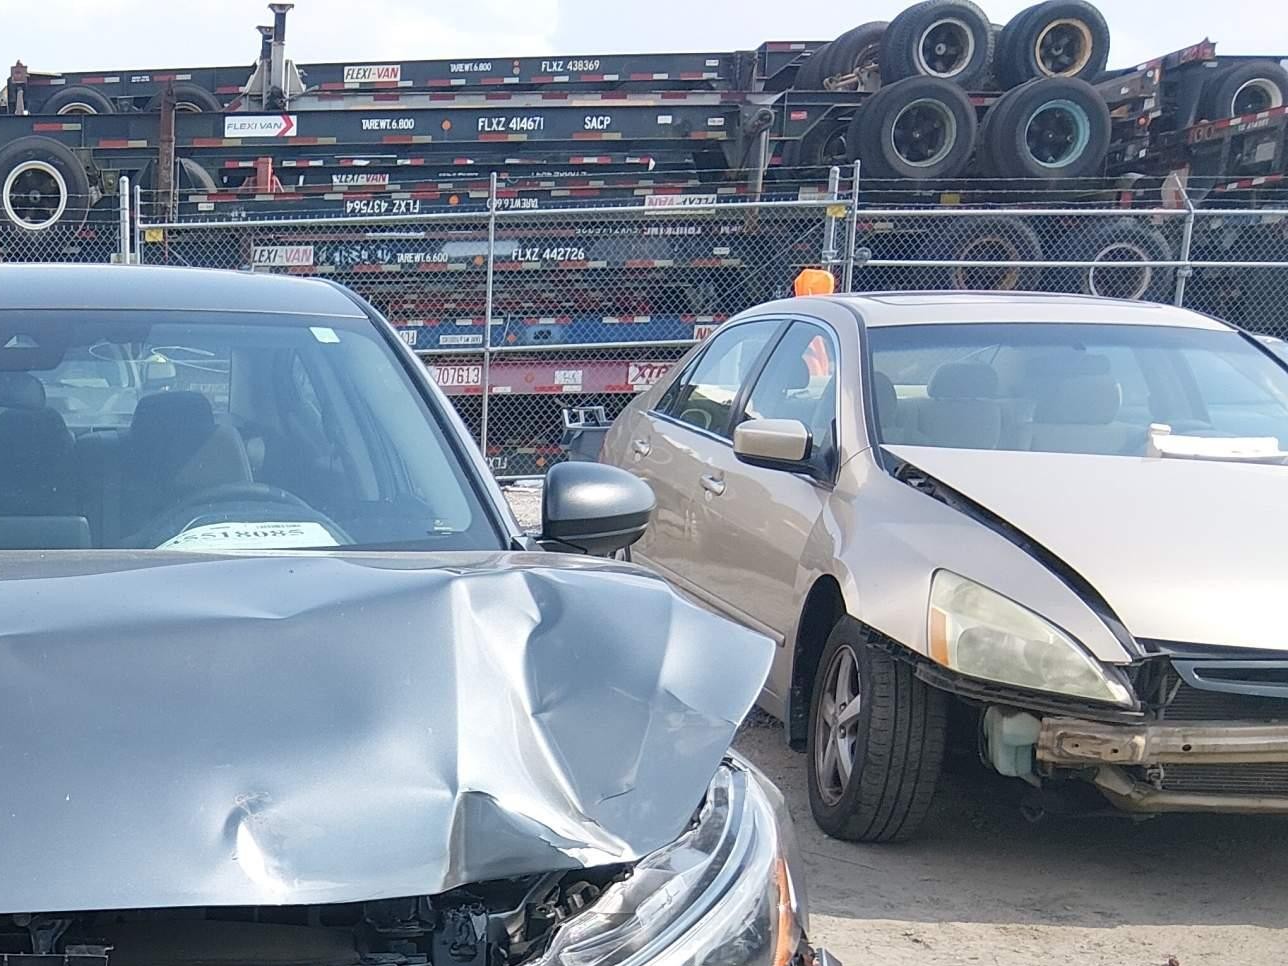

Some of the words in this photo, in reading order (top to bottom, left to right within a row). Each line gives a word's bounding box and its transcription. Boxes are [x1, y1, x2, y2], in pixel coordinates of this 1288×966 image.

[542, 61, 563, 72] FLXZ
[567, 60, 600, 71] 438369
[344, 67, 399, 80] FLEXI-VAN
[226, 123, 257, 131] FLEXI
[259, 122, 282, 130] VAN
[478, 118, 506, 131] FLXZ
[509, 117, 544, 131] 414671
[584, 116, 611, 129] SACP
[346, 200, 388, 213] 437564
[393, 200, 420, 213] FLXZ
[252, 249, 312, 263] LEXI-VAN
[512, 249, 539, 261] FLXZ
[542, 248, 585, 260] 442726
[436, 367, 480, 384] 707613
[487, 457, 507, 470] FLX
